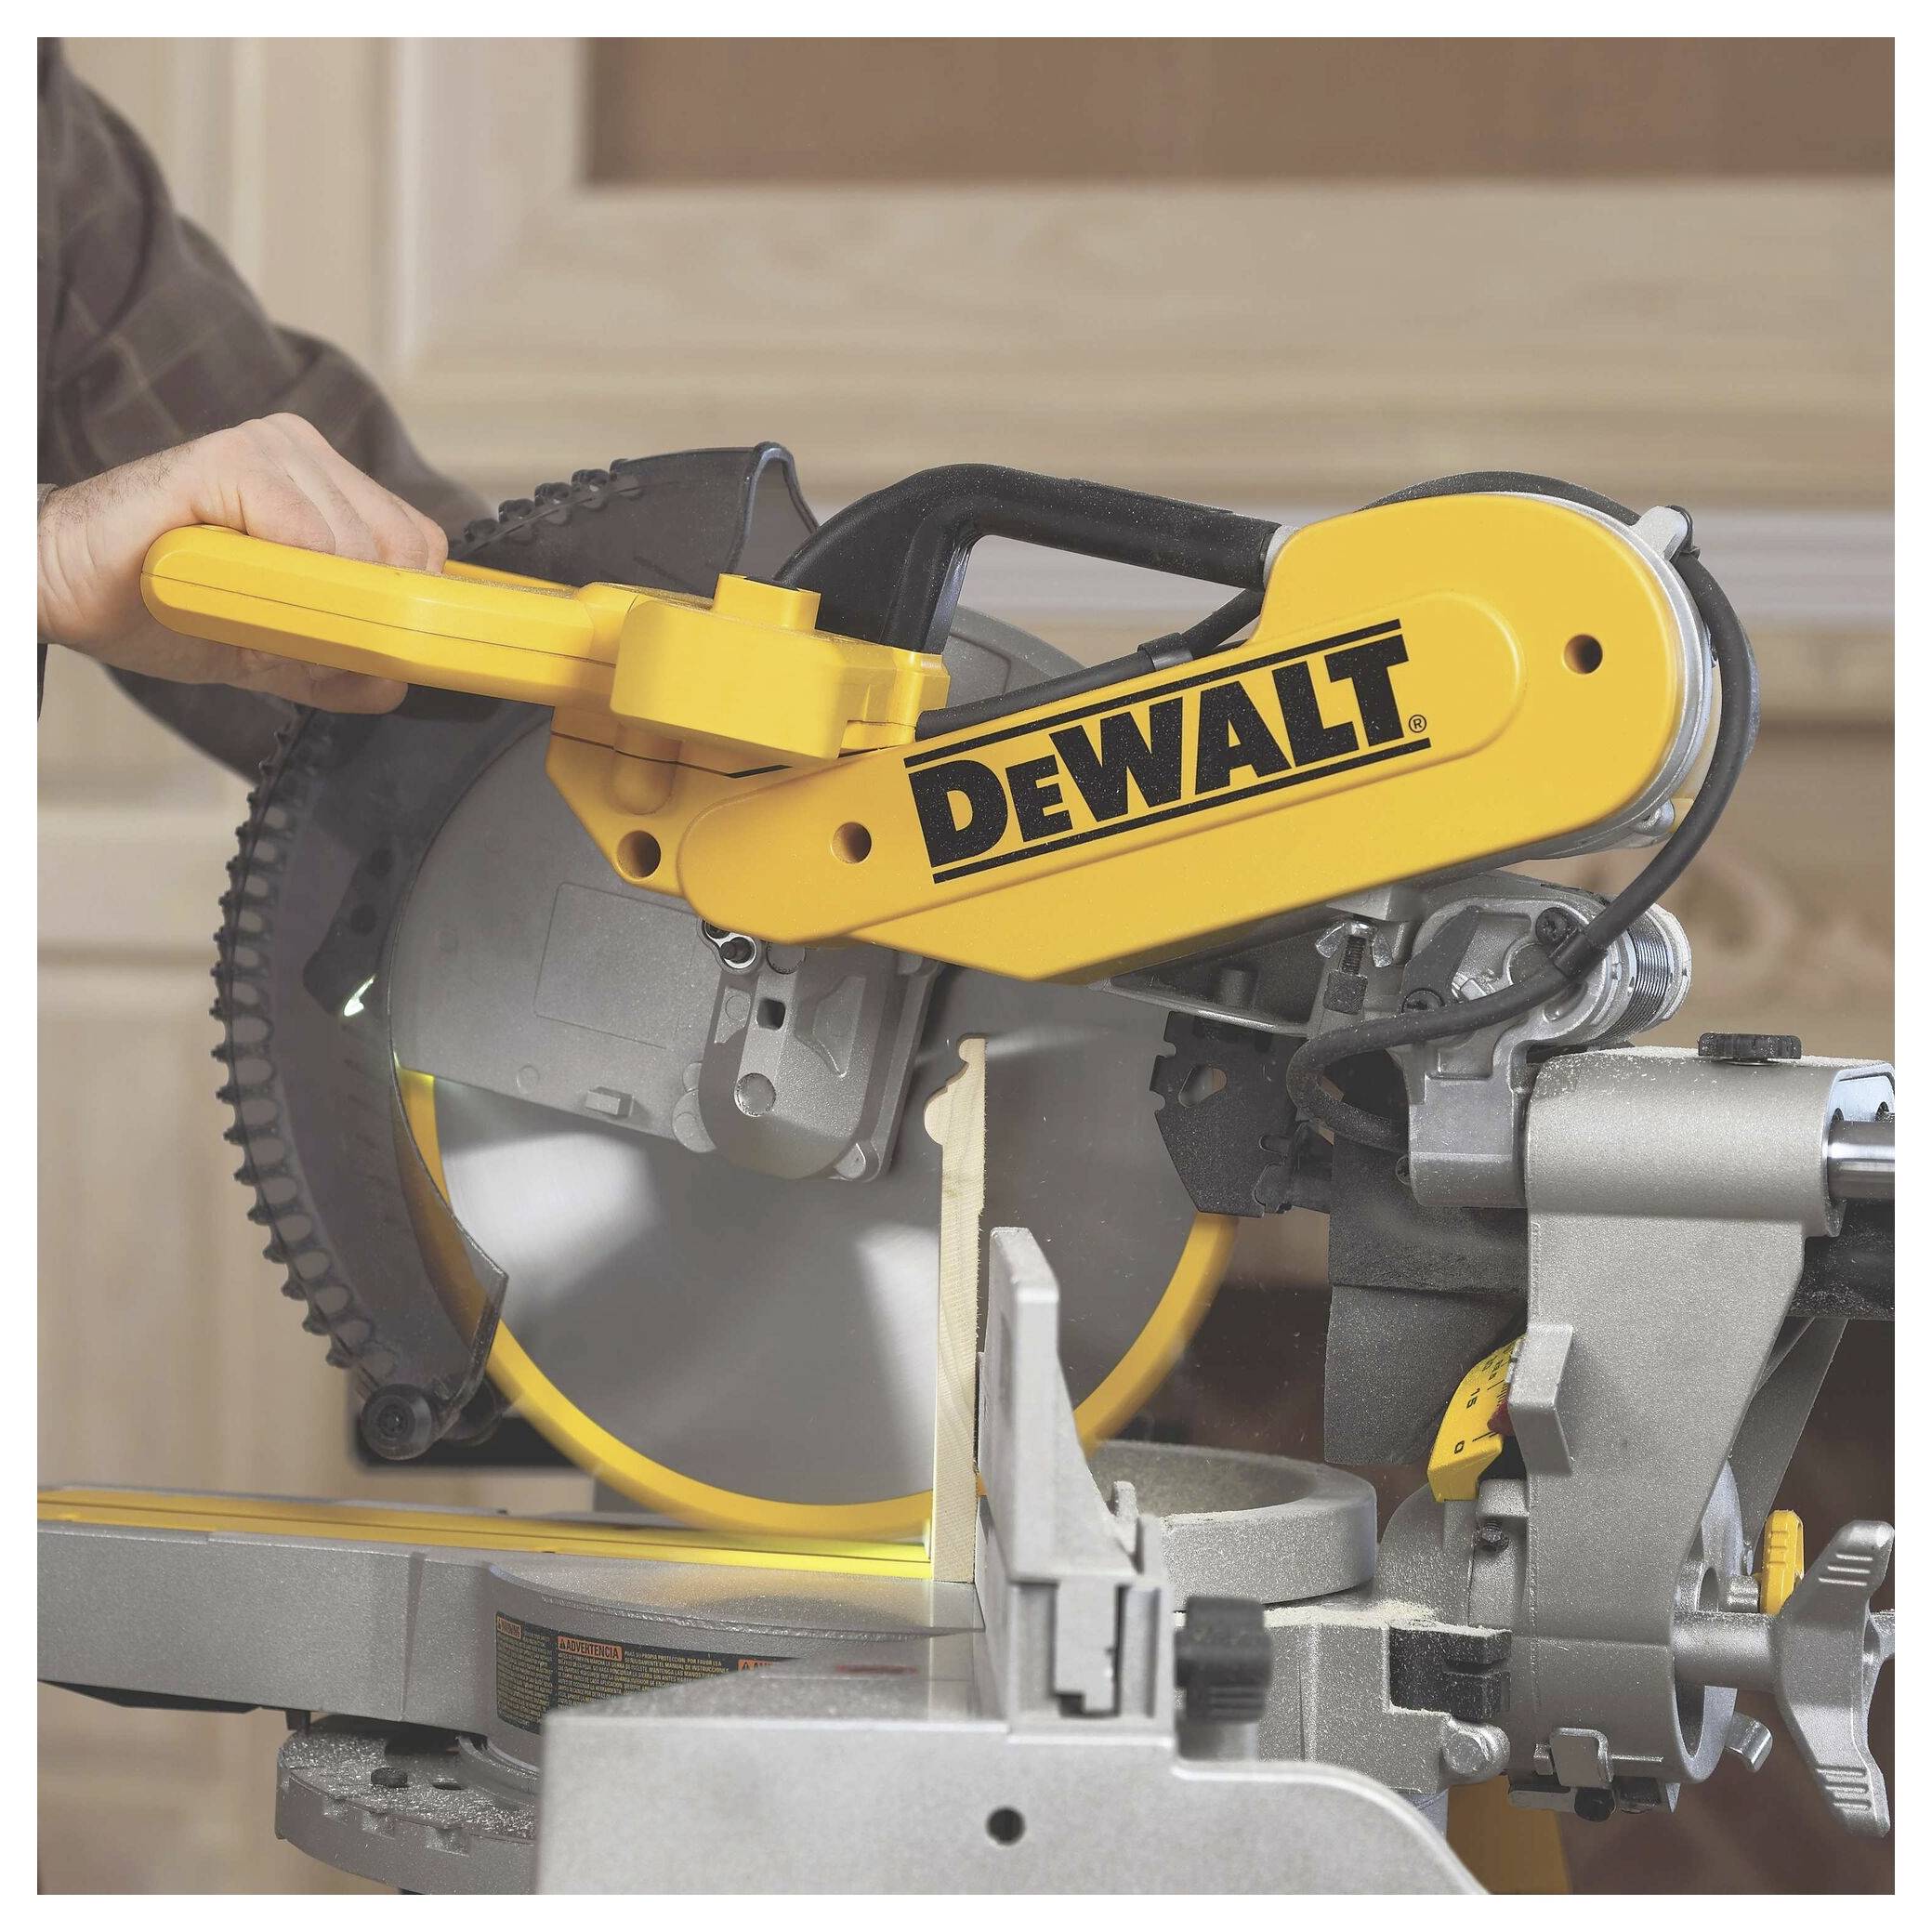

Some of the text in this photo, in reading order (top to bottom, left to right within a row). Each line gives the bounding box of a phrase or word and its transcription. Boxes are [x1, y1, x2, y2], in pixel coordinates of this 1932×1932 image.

[908, 634, 1410, 868] DEWALT
[1465, 1387, 1481, 1409] 15
[566, 1639, 620, 1660] ADVERTENCIA
